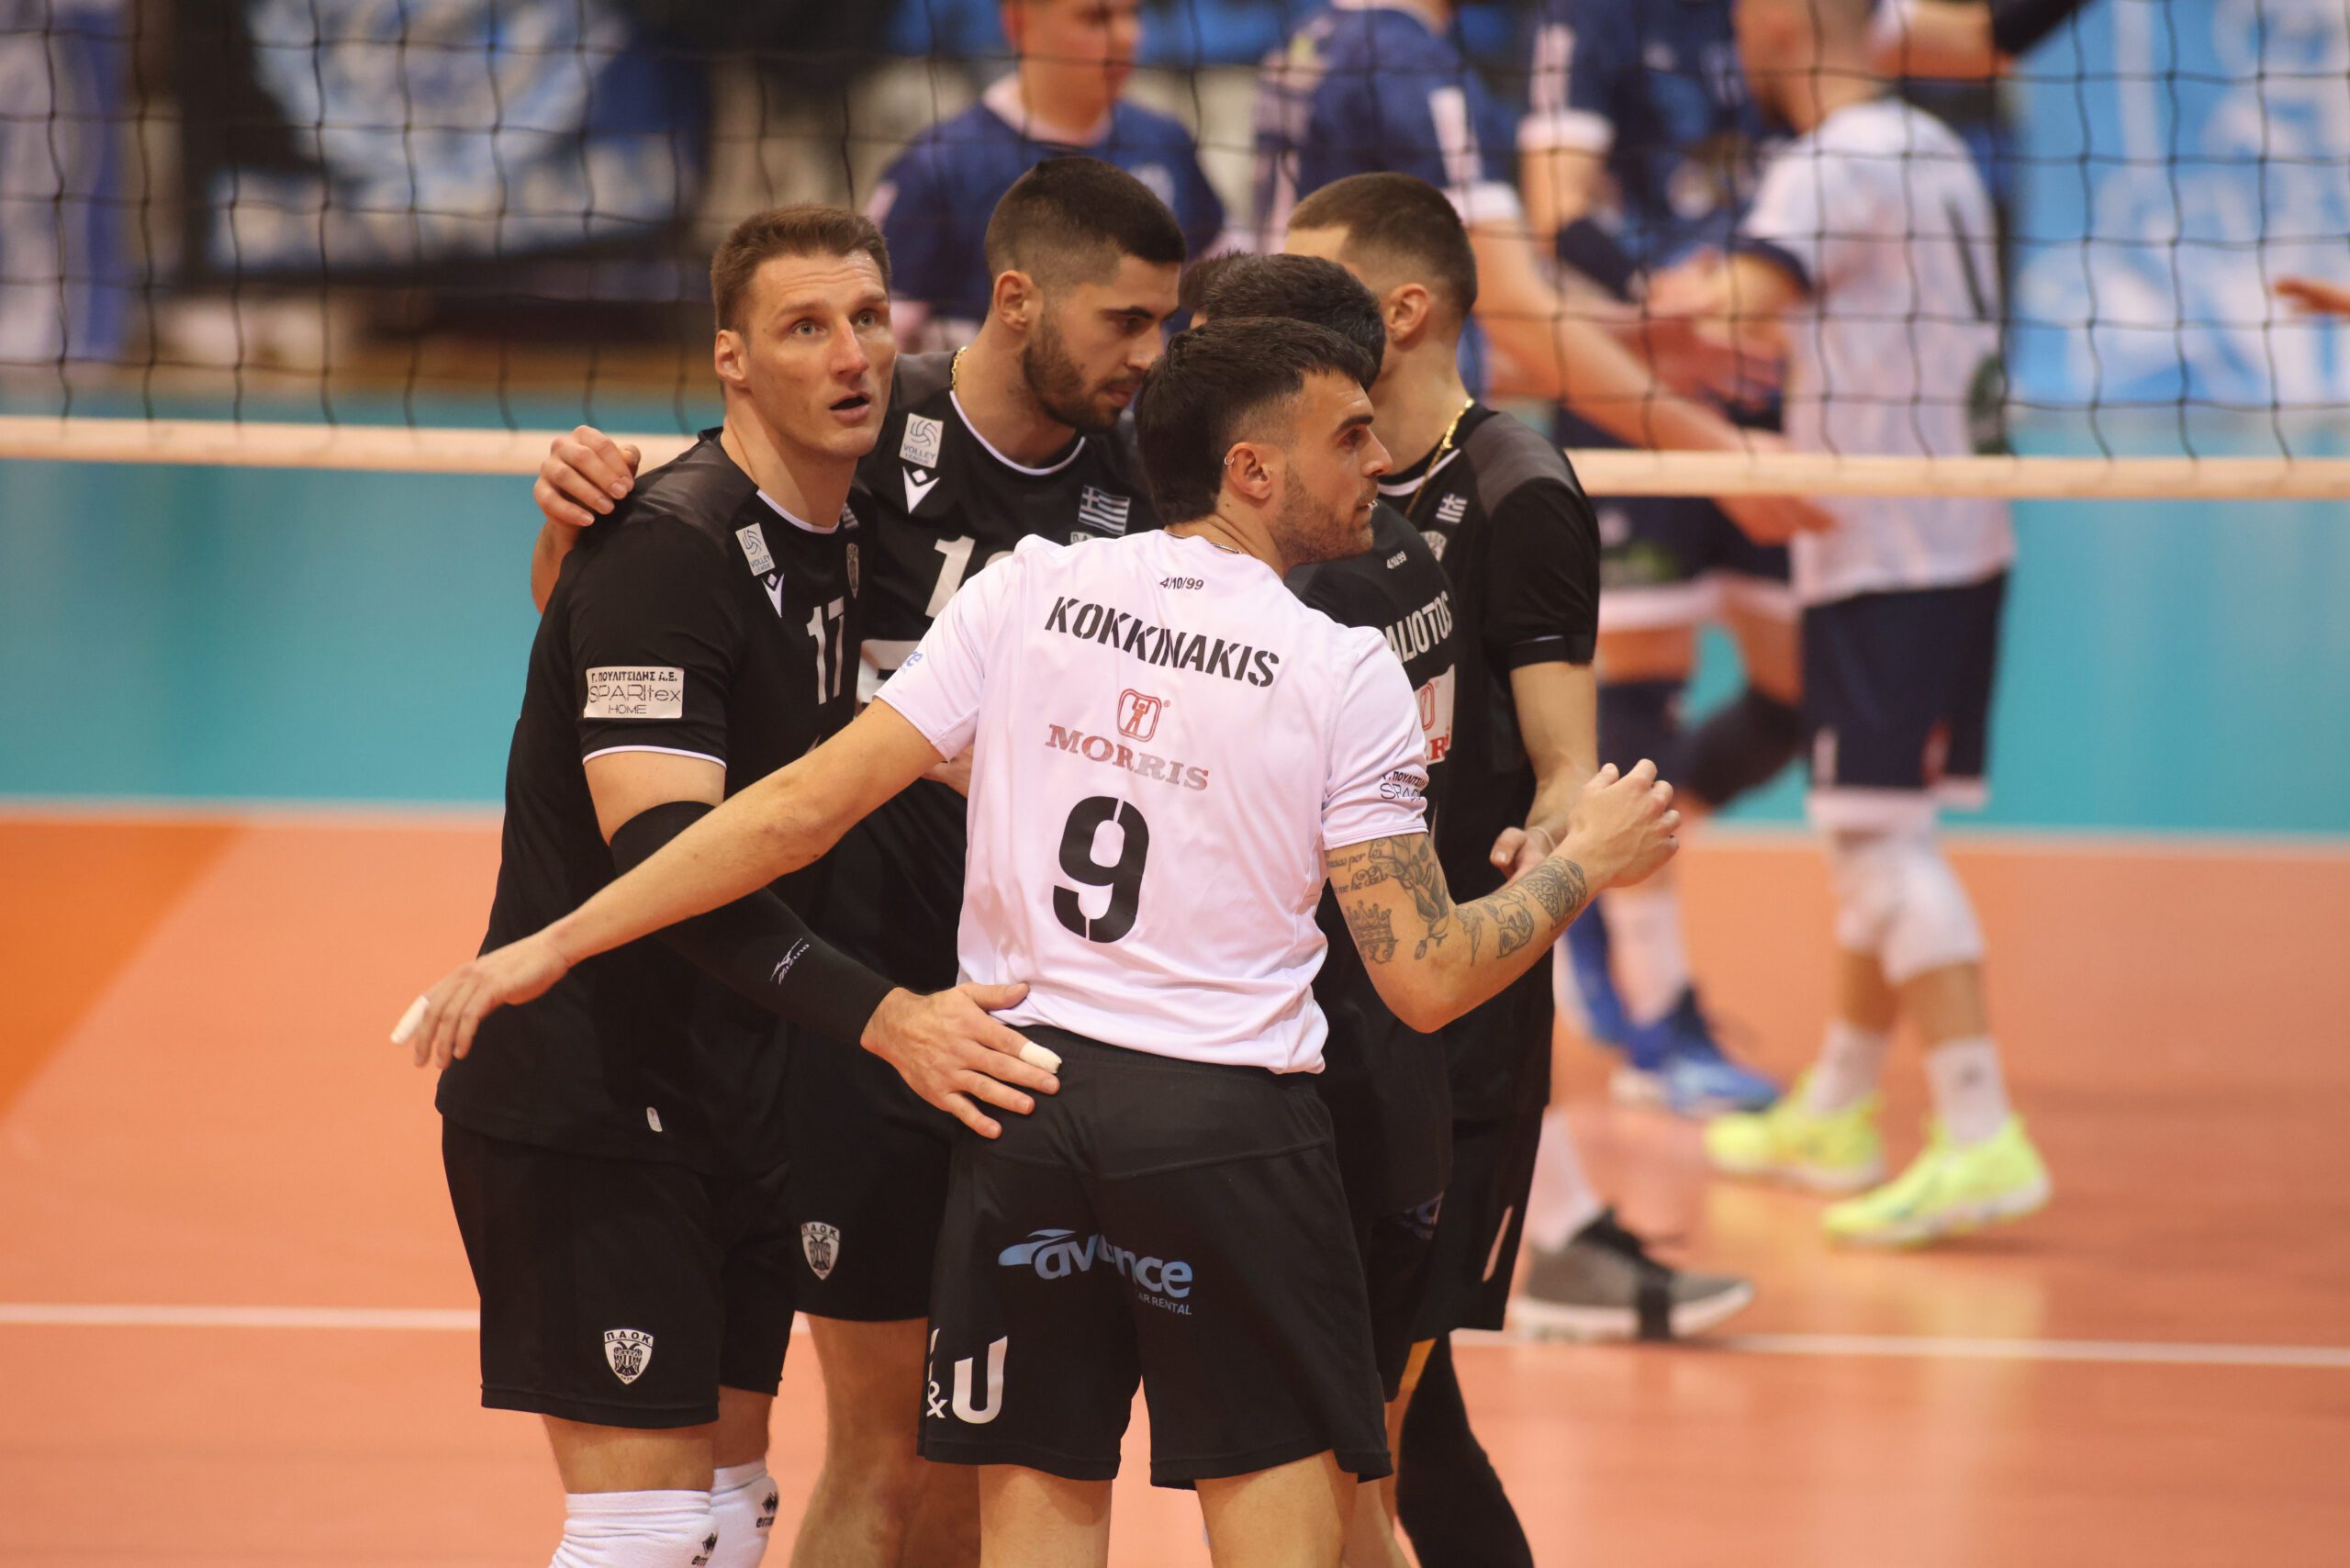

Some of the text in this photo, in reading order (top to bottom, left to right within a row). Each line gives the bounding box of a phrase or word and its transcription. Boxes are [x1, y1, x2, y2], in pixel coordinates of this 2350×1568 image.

[903, 443, 936, 460] VOLLEY
[750, 554, 771, 567] VOLLEY
[1159, 577, 1204, 590] 4/10/99
[1045, 596, 1280, 688] KOKKINAKIS
[1385, 590, 1452, 664] ALIOTOS
[806, 596, 845, 706] 17
[608, 704, 647, 714] HOME
[1045, 723, 1209, 791] MORRIS
[1053, 795, 1150, 943] 9
[1135, 1291, 1193, 1316] AR RENTAL
